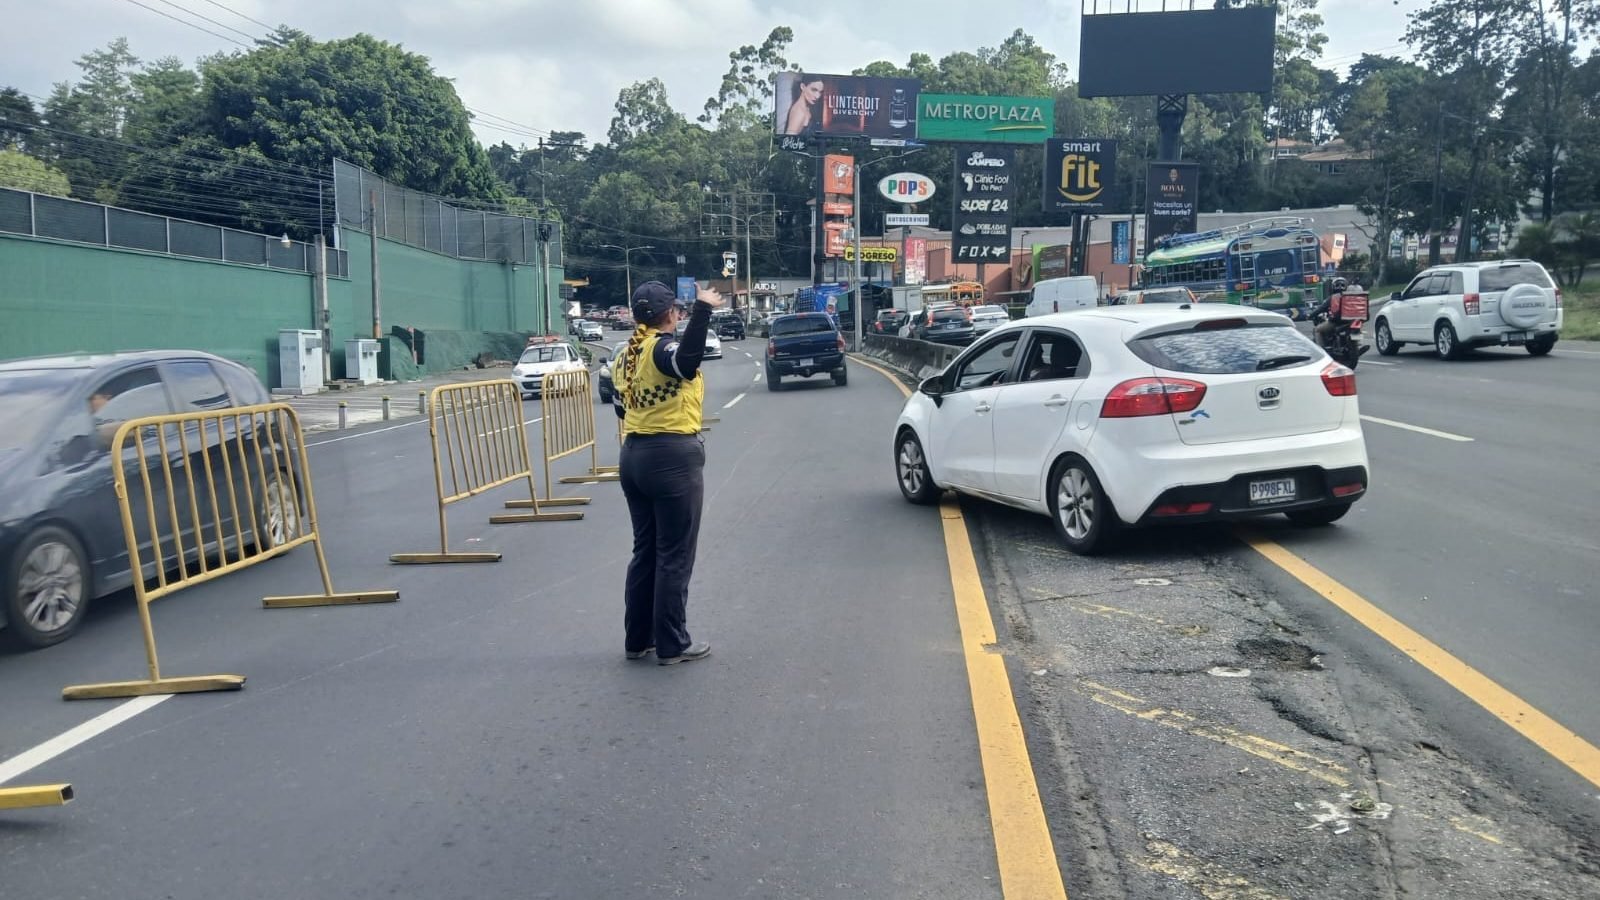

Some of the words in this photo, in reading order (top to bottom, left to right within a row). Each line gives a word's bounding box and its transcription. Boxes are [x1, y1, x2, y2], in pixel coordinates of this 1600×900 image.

[828, 95, 881, 111] L'INTERDIT
[832, 109, 876, 117] GIVENCHY
[925, 101, 1043, 121] METROPLAZA
[1062, 141, 1101, 152] smart
[1061, 154, 1100, 189] fit
[887, 180, 928, 196] POPS
[1160, 184, 1186, 193] ROYAL
[960, 199, 992, 212] super
[991, 199, 1009, 212] 24
[1153, 208, 1171, 216] buen
[958, 246, 990, 257] FOX
[754, 283, 770, 291] AUTO
[1262, 388, 1278, 398] KIA
[1251, 480, 1295, 499] P998FXL
